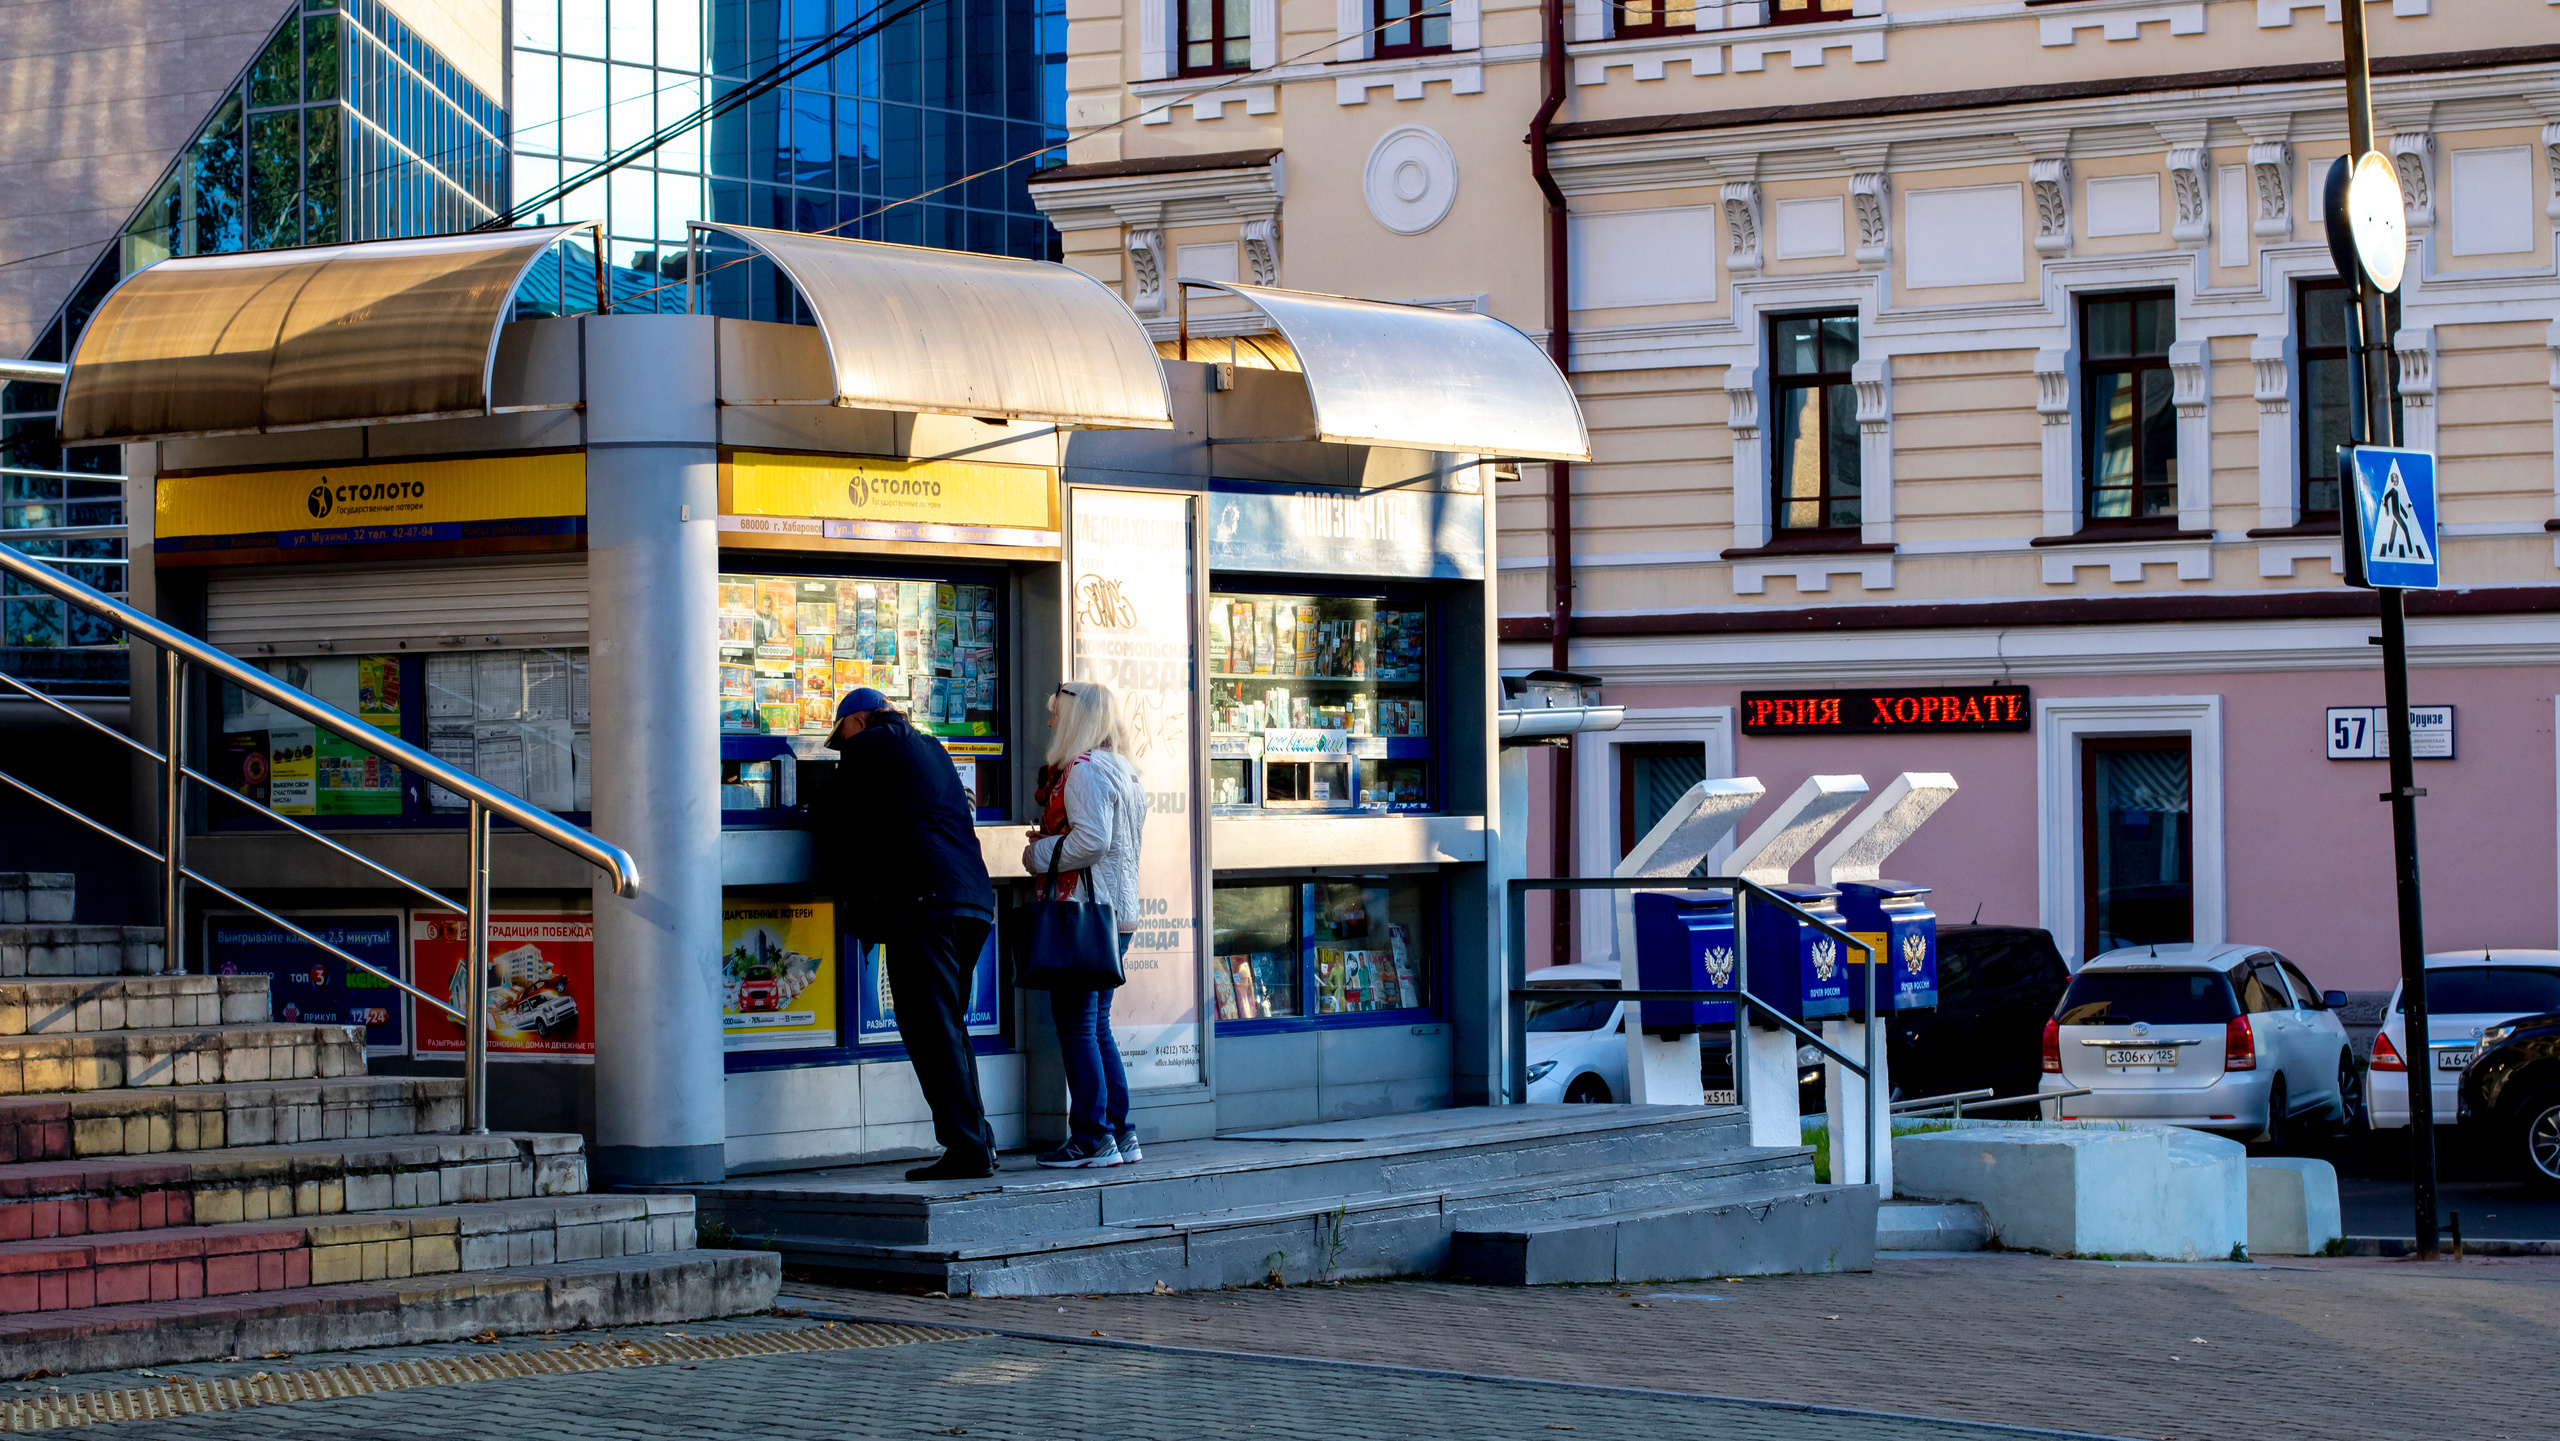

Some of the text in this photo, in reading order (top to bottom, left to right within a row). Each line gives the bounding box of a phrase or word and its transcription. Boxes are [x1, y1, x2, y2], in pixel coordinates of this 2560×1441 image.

[336, 481, 425, 502] СТОЛОТО
[870, 478, 941, 497] СТОЛОТО
[336, 502, 424, 516] Государственные лотереи
[1294, 491, 1404, 541] СОЮЗПЕЧАТЬ
[740, 518, 770, 530] 680000
[773, 522, 780, 531] г.
[836, 525, 849, 537] ул.
[293, 526, 434, 546] ул. Мухина, 32 тел. 42-47-94
[1748, 698, 1841, 726] РБИЯ
[2334, 717, 2367, 749] 57
[1137, 897, 1168, 917] ДИО
[723, 908, 814, 921] ДАРСТВЕННЫЕ ЛОТЕРЕИ
[217, 930, 284, 945] Выигрывайте
[328, 930, 344, 945] 2,5
[346, 930, 390, 946] минуты!
[488, 926, 540, 939] ТРАДИЦИЯ
[1123, 957, 1159, 972] баровск
[315, 970, 325, 986] 3
[1914, 980, 1931, 990] РОССИИ
[1810, 987, 1841, 998] ПОЧТА РОССИИ
[303, 1012, 338, 1022] ПРИКУП
[970, 1012, 991, 1024] ДОМА
[427, 1038, 467, 1048] РАЗЫГРЫВА
[525, 1042, 545, 1051] ДОМА
[550, 1042, 587, 1052] ДЕНЕЖНЫЕ
[1160, 1045, 1178, 1057] (4212)
[2156, 1050, 2173, 1060] 125
[2445, 1053, 2474, 1067] А64
